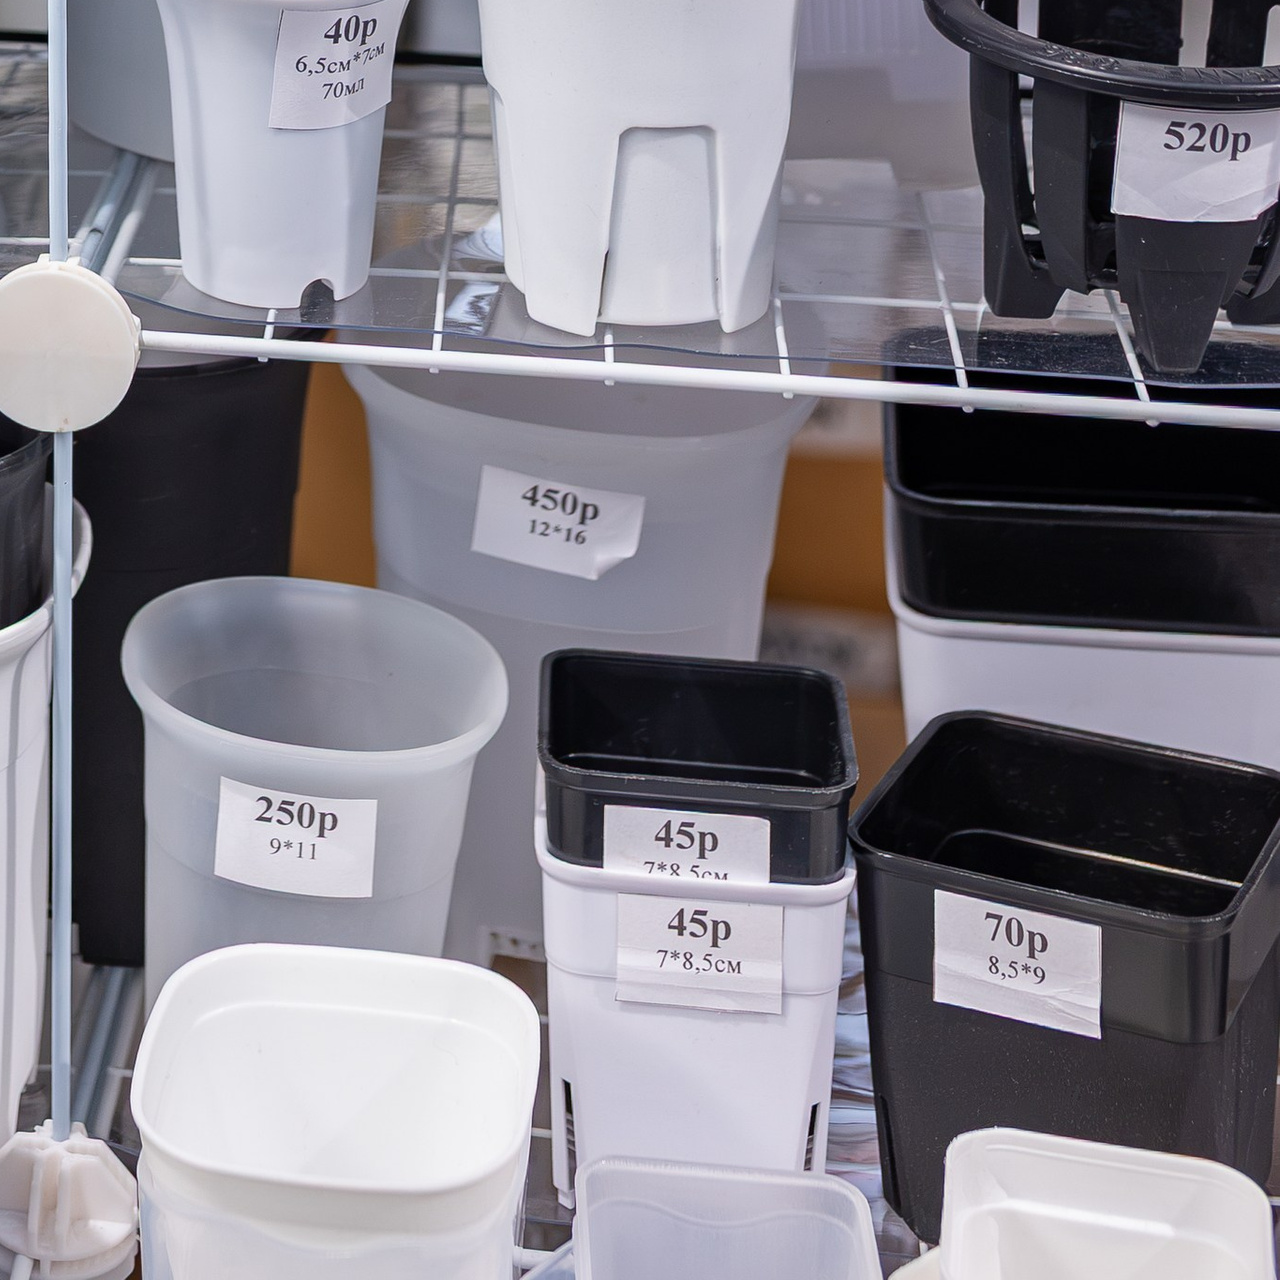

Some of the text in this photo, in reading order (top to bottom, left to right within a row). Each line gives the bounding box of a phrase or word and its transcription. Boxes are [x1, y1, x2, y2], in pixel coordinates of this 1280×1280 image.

[323, 16, 377, 46] 40р
[322, 75, 365, 100] 70мл
[1163, 120, 1252, 160] 520р
[521, 482, 601, 525] 450р
[254, 797, 339, 838] 250р
[654, 819, 719, 859] 45р
[668, 909, 732, 947] 45р
[984, 912, 1048, 959] 70р
